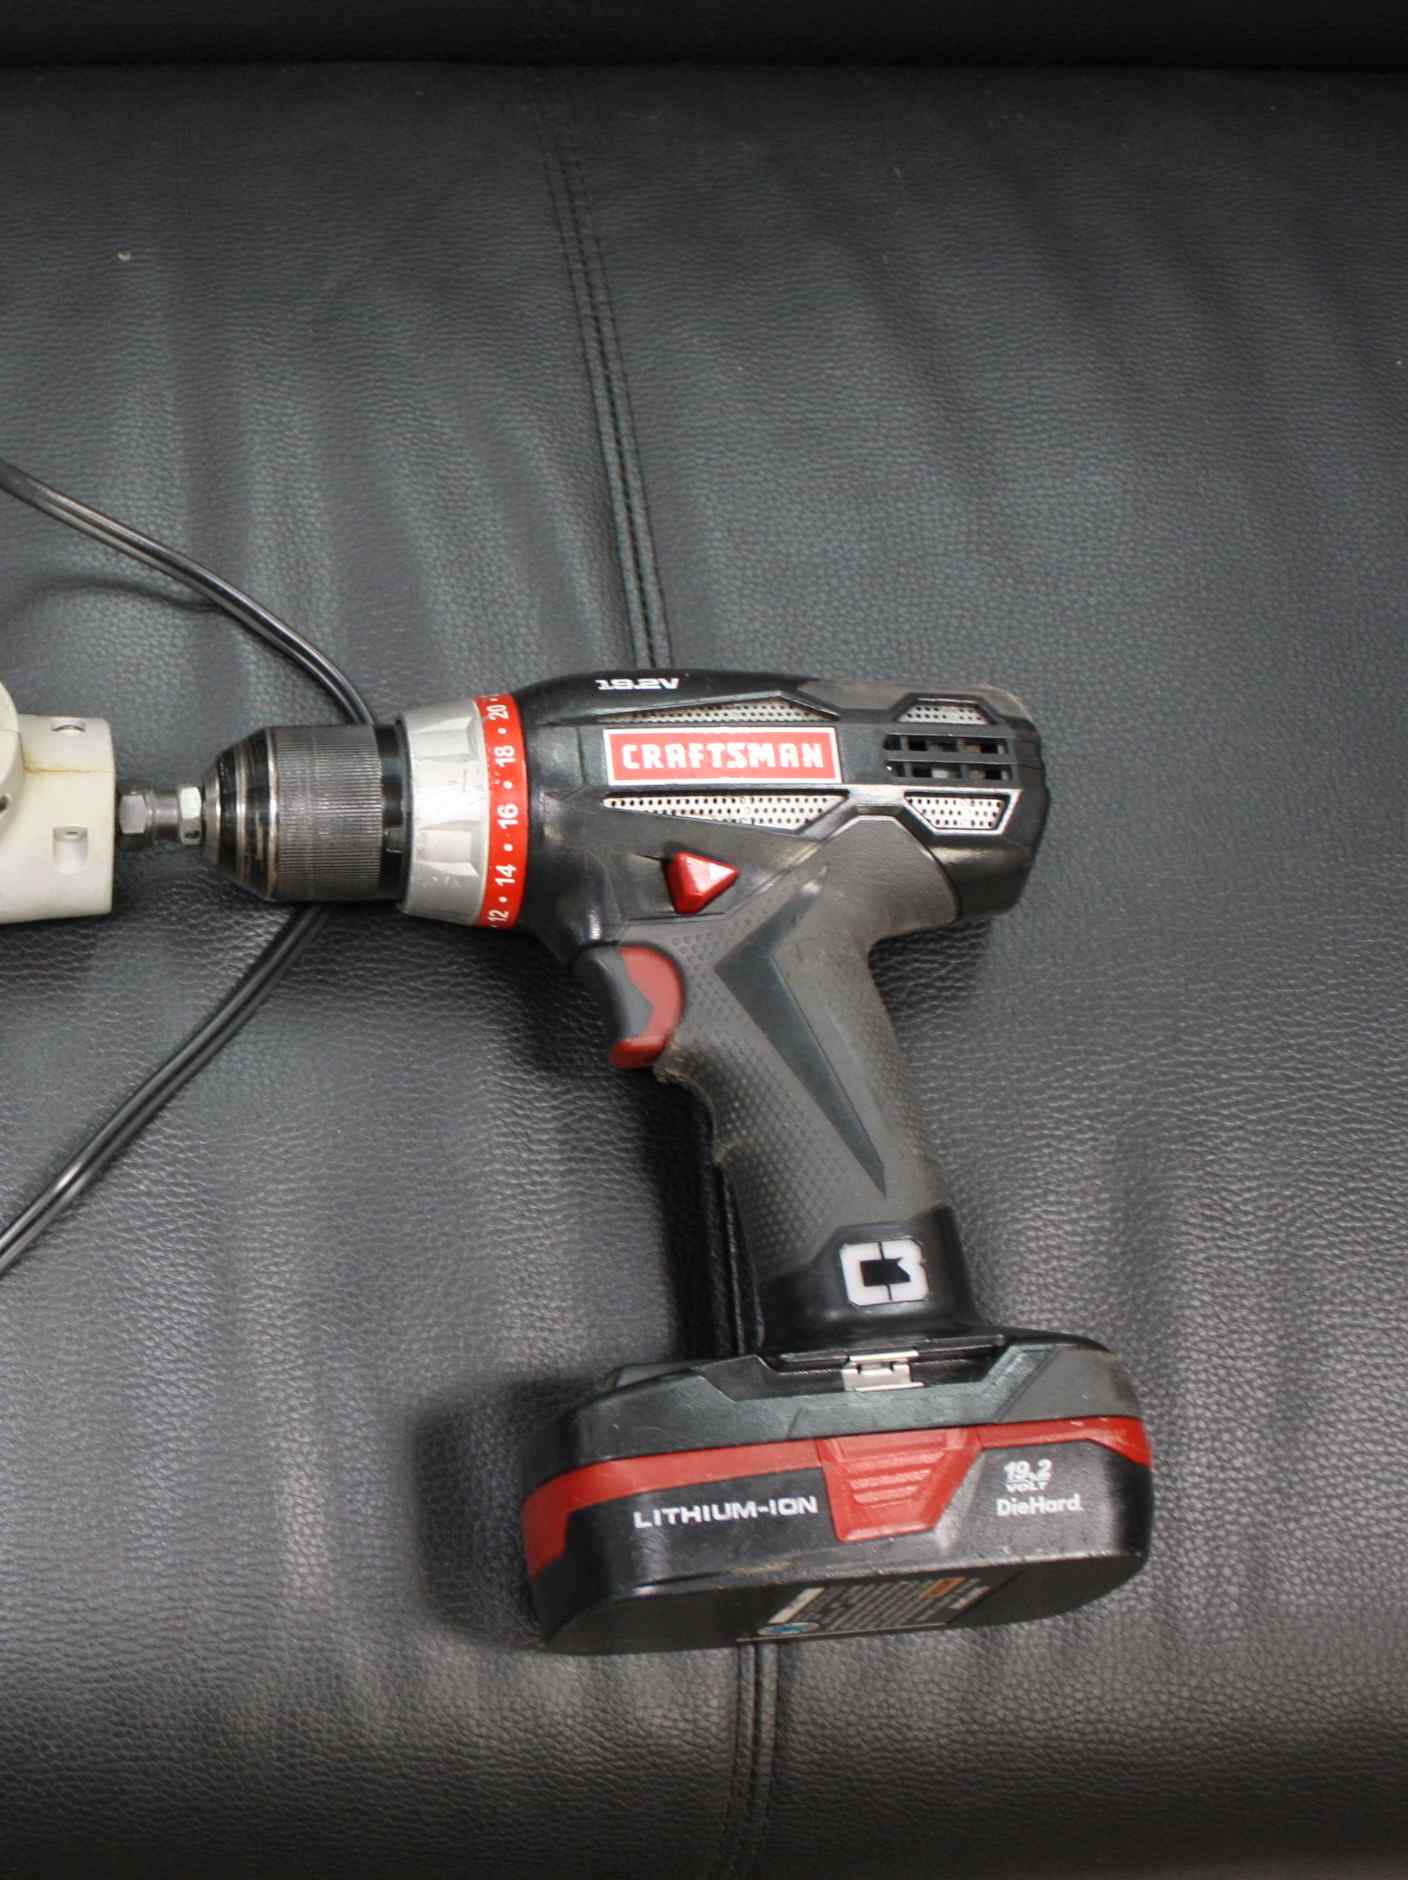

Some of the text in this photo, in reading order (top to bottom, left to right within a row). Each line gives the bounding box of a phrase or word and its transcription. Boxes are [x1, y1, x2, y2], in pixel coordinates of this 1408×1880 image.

[594, 677, 680, 690] 19.2V
[486, 704, 510, 721] 20
[493, 745, 516, 768] 18
[621, 742, 824, 769] CRAFTSMAN
[496, 803, 519, 830] 16
[495, 864, 517, 887] 14
[488, 909, 510, 922] 12
[1004, 1458, 1053, 1481] 19.2
[632, 1495, 819, 1529] LITHIUM-ION
